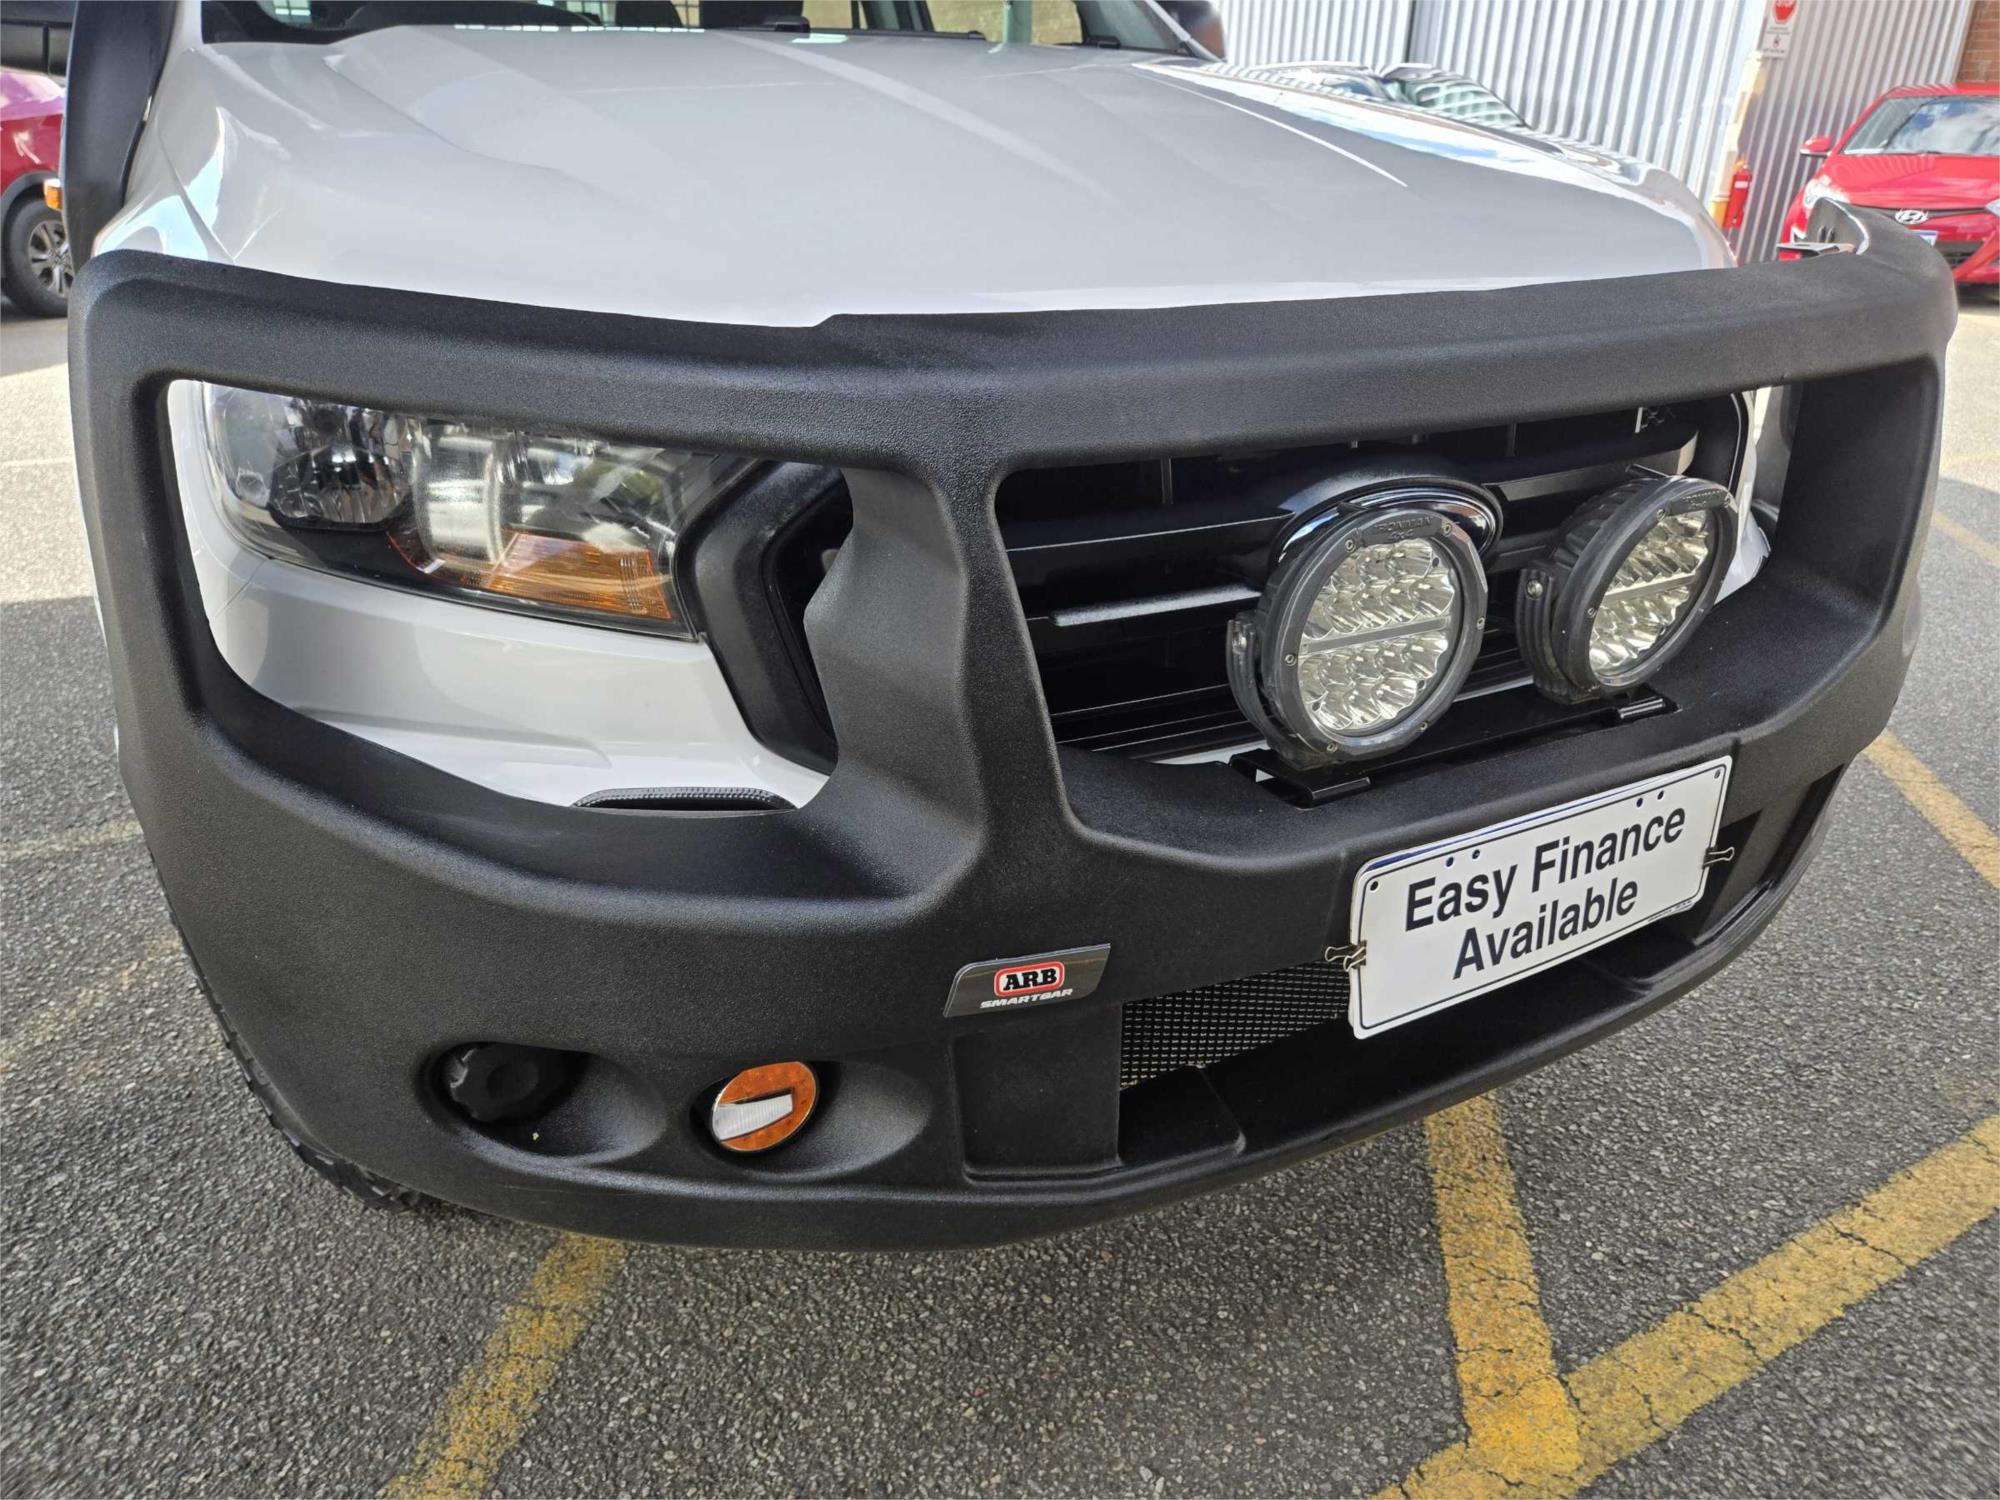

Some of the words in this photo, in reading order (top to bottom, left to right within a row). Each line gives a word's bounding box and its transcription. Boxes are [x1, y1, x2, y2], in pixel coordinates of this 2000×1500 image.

[1405, 864, 1517, 931] Easy
[1531, 808, 1685, 893] Finance
[1452, 879, 1637, 979] Available
[980, 988, 1073, 1009] SMARTBAR
[1003, 968, 1057, 991] ARB
